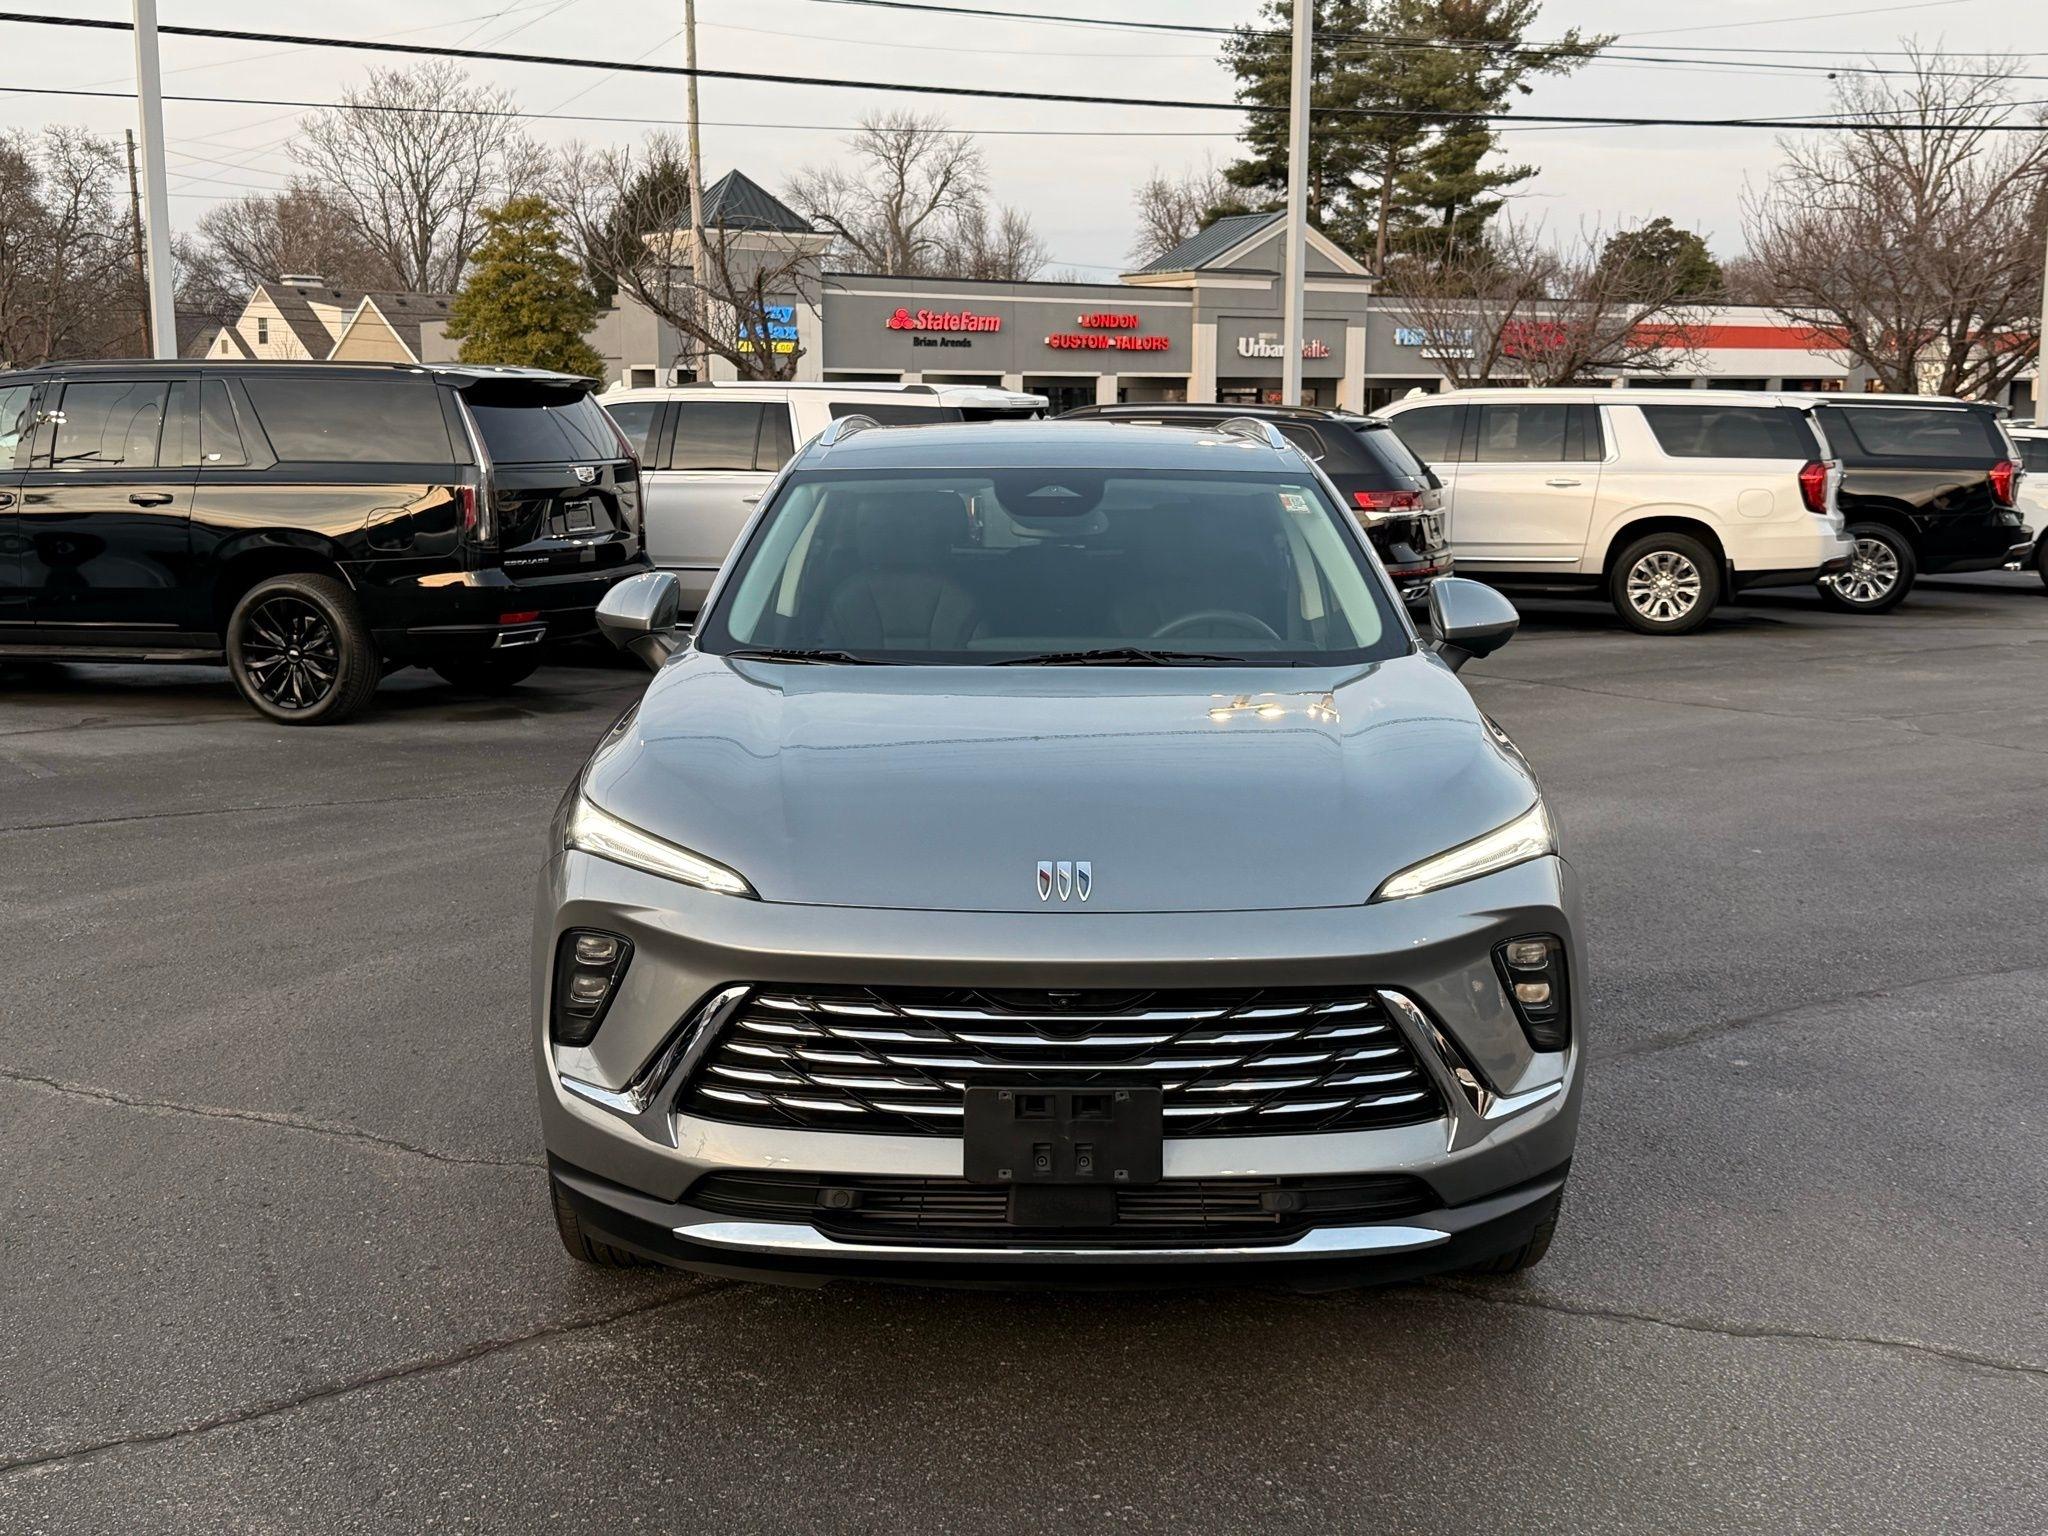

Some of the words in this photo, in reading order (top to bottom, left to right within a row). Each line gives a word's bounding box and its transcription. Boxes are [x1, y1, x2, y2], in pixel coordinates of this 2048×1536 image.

[917, 309, 1001, 332] StateFarm
[1081, 313, 1140, 328] LONDON
[913, 336, 938, 348] Brian
[939, 337, 972, 349] Arends
[1049, 332, 1110, 349] CUSTOM
[1114, 335, 1172, 351] TAILORS
